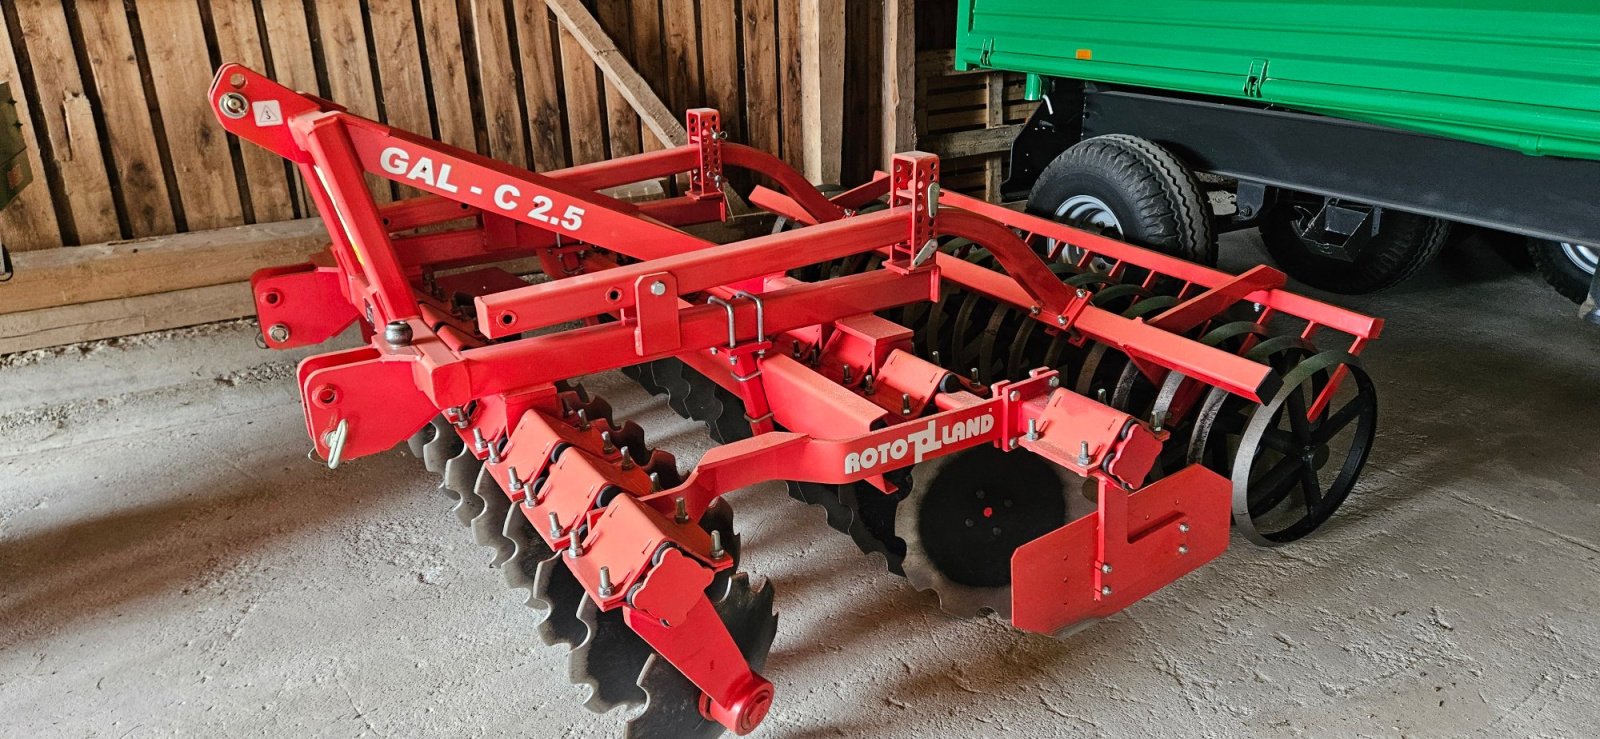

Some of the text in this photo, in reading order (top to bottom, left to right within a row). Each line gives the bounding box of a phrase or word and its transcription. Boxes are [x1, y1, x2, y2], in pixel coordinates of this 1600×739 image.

[380, 147, 586, 231] GAL - C 2.5
